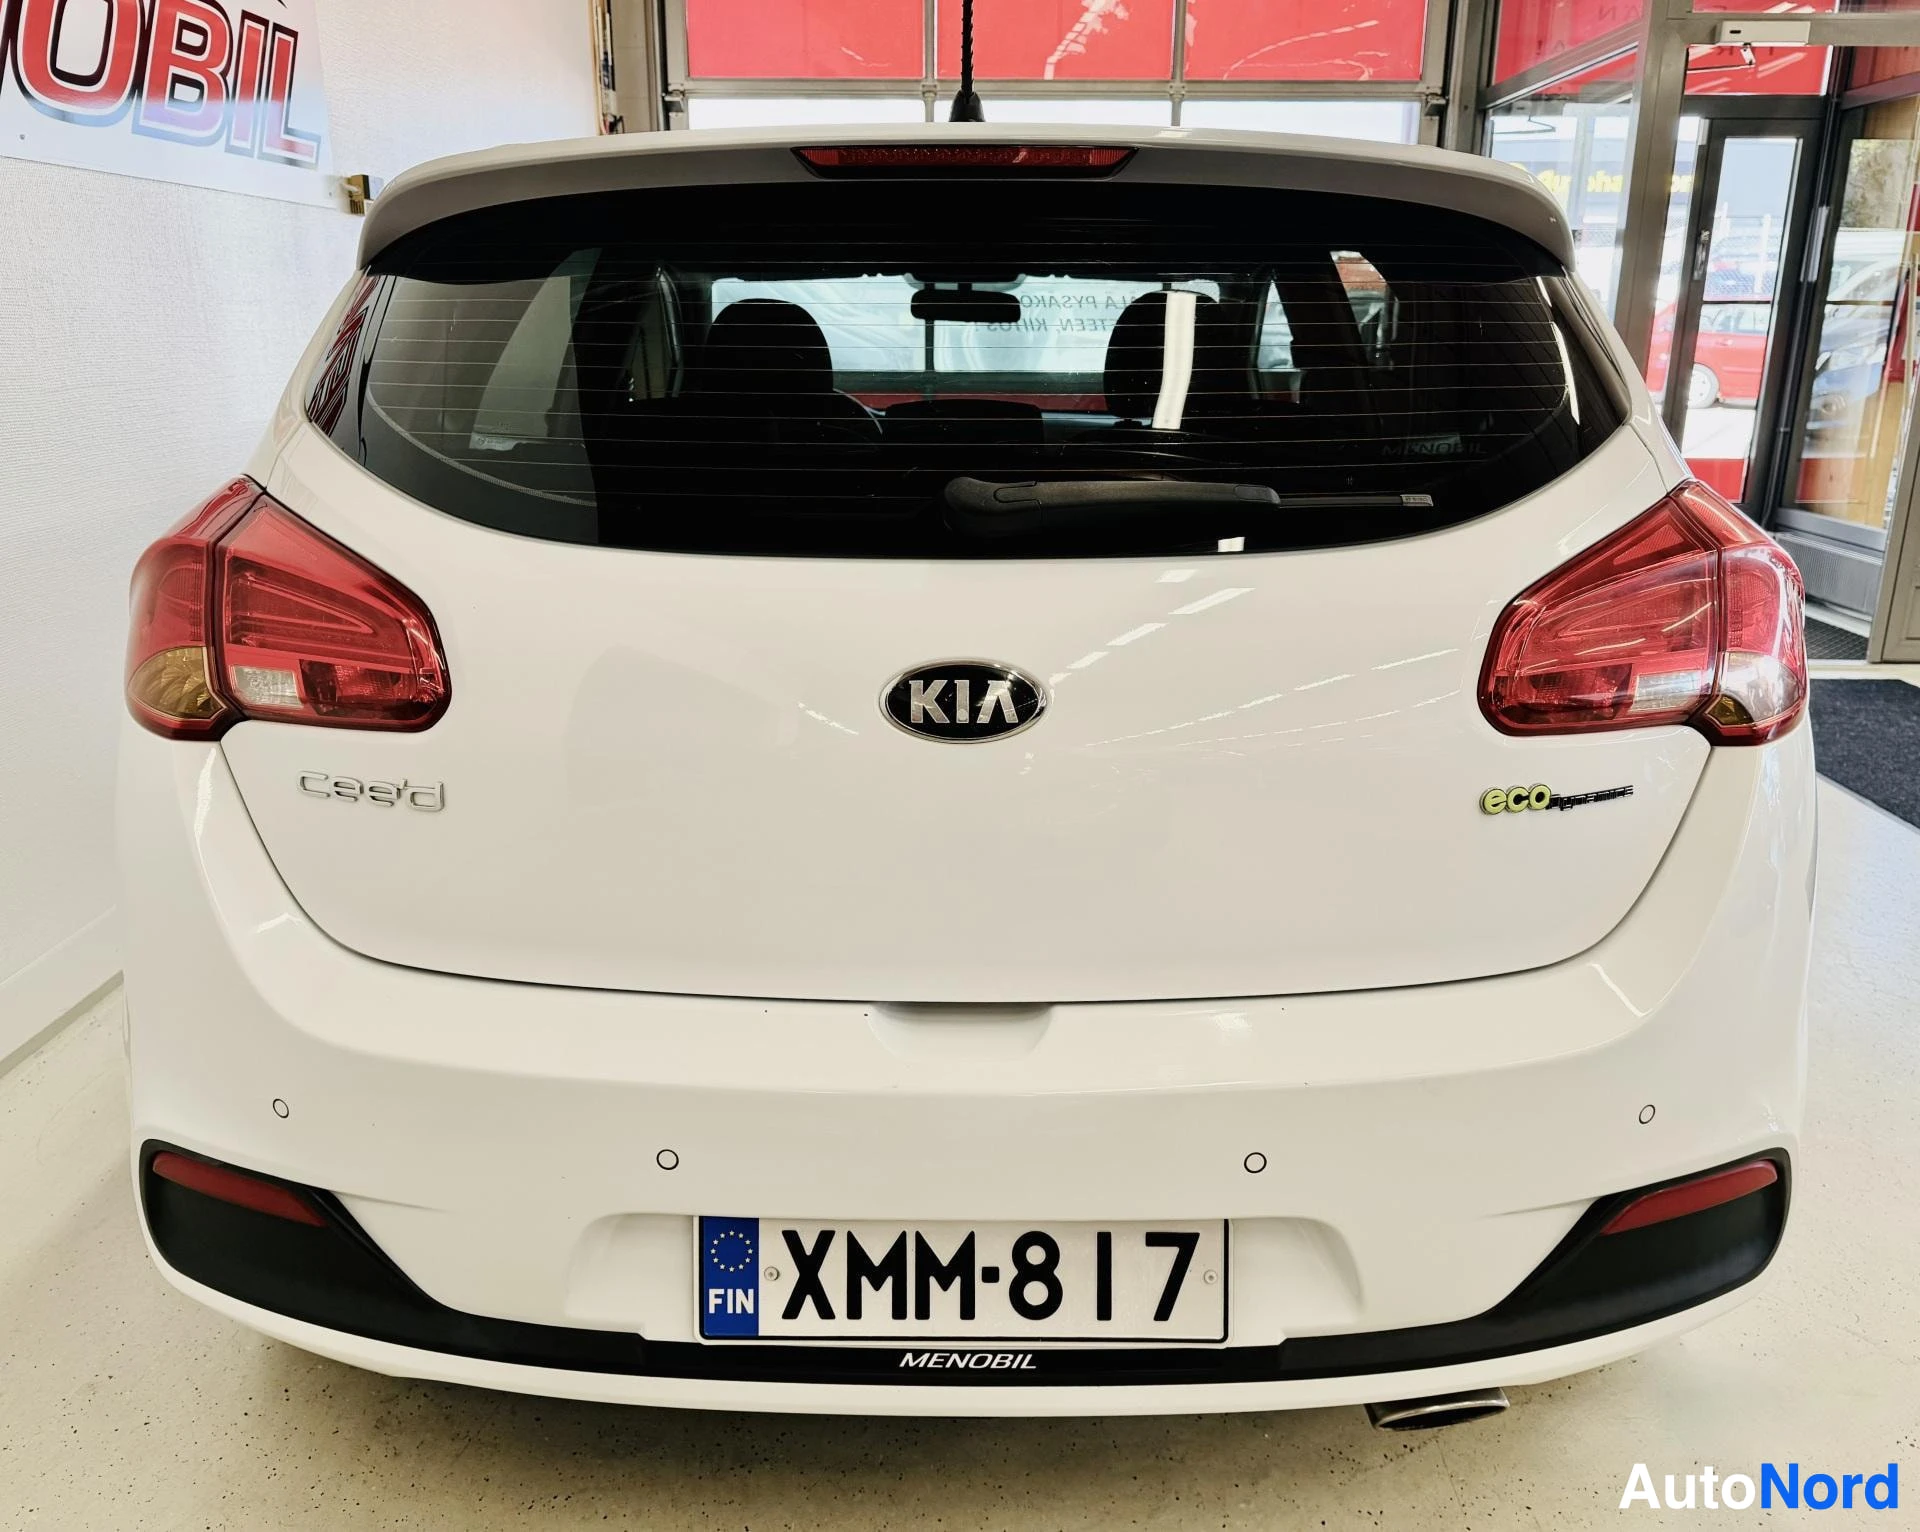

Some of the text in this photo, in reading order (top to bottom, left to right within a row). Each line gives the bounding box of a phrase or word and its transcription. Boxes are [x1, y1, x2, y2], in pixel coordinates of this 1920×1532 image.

[0, 0, 321, 171] OBIL
[908, 679, 1019, 724] KIA
[781, 1230, 1200, 1321] XMM-817
[708, 1288, 754, 1314] FIN
[899, 1352, 1037, 1370] MENOBIL
